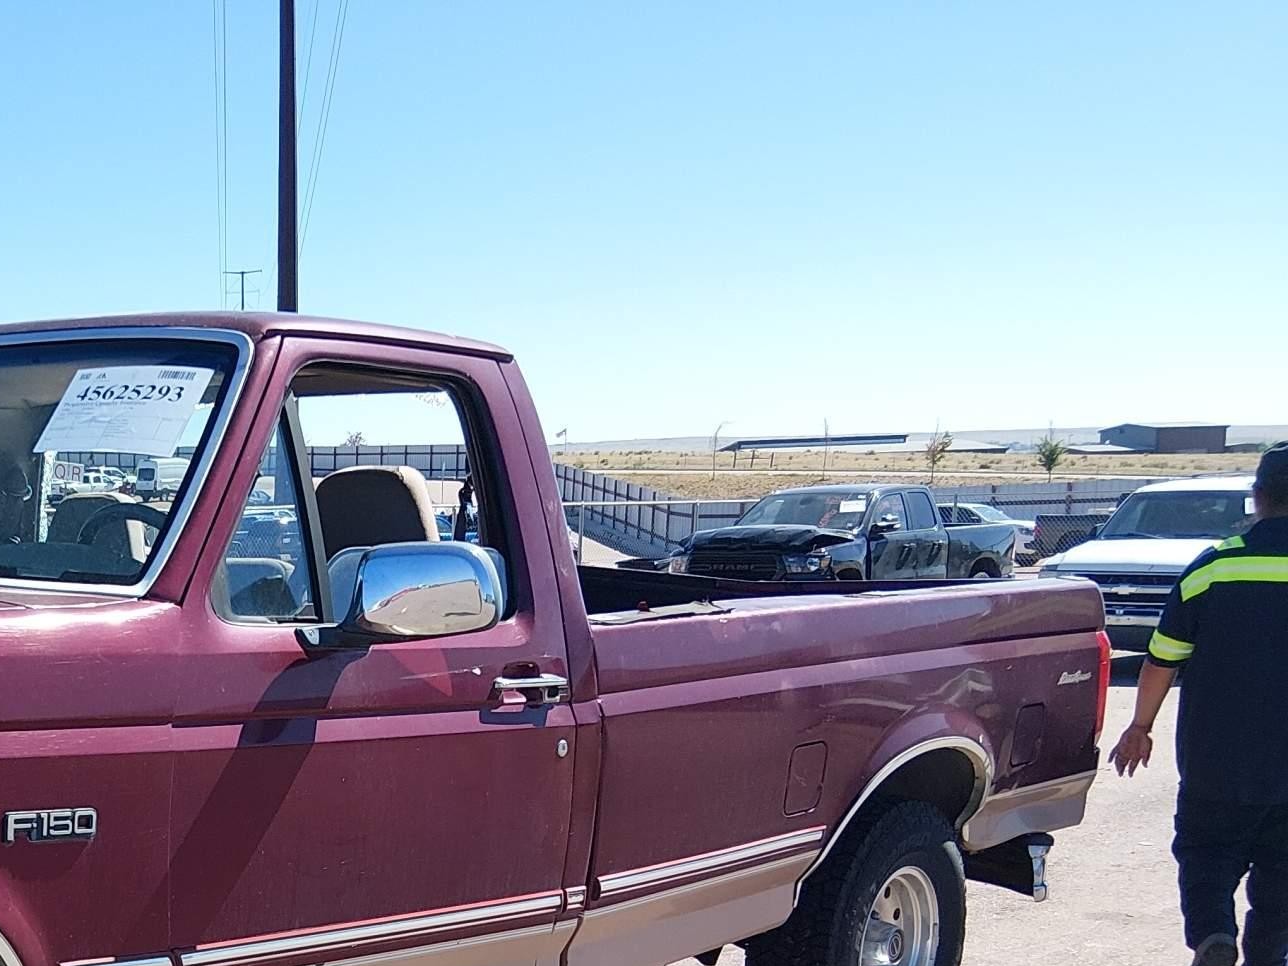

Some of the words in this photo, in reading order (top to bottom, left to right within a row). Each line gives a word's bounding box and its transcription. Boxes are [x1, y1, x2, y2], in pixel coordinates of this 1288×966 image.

[77, 384, 185, 402] 45625293
[55, 463, 66, 480] Q
[72, 466, 81, 481] R
